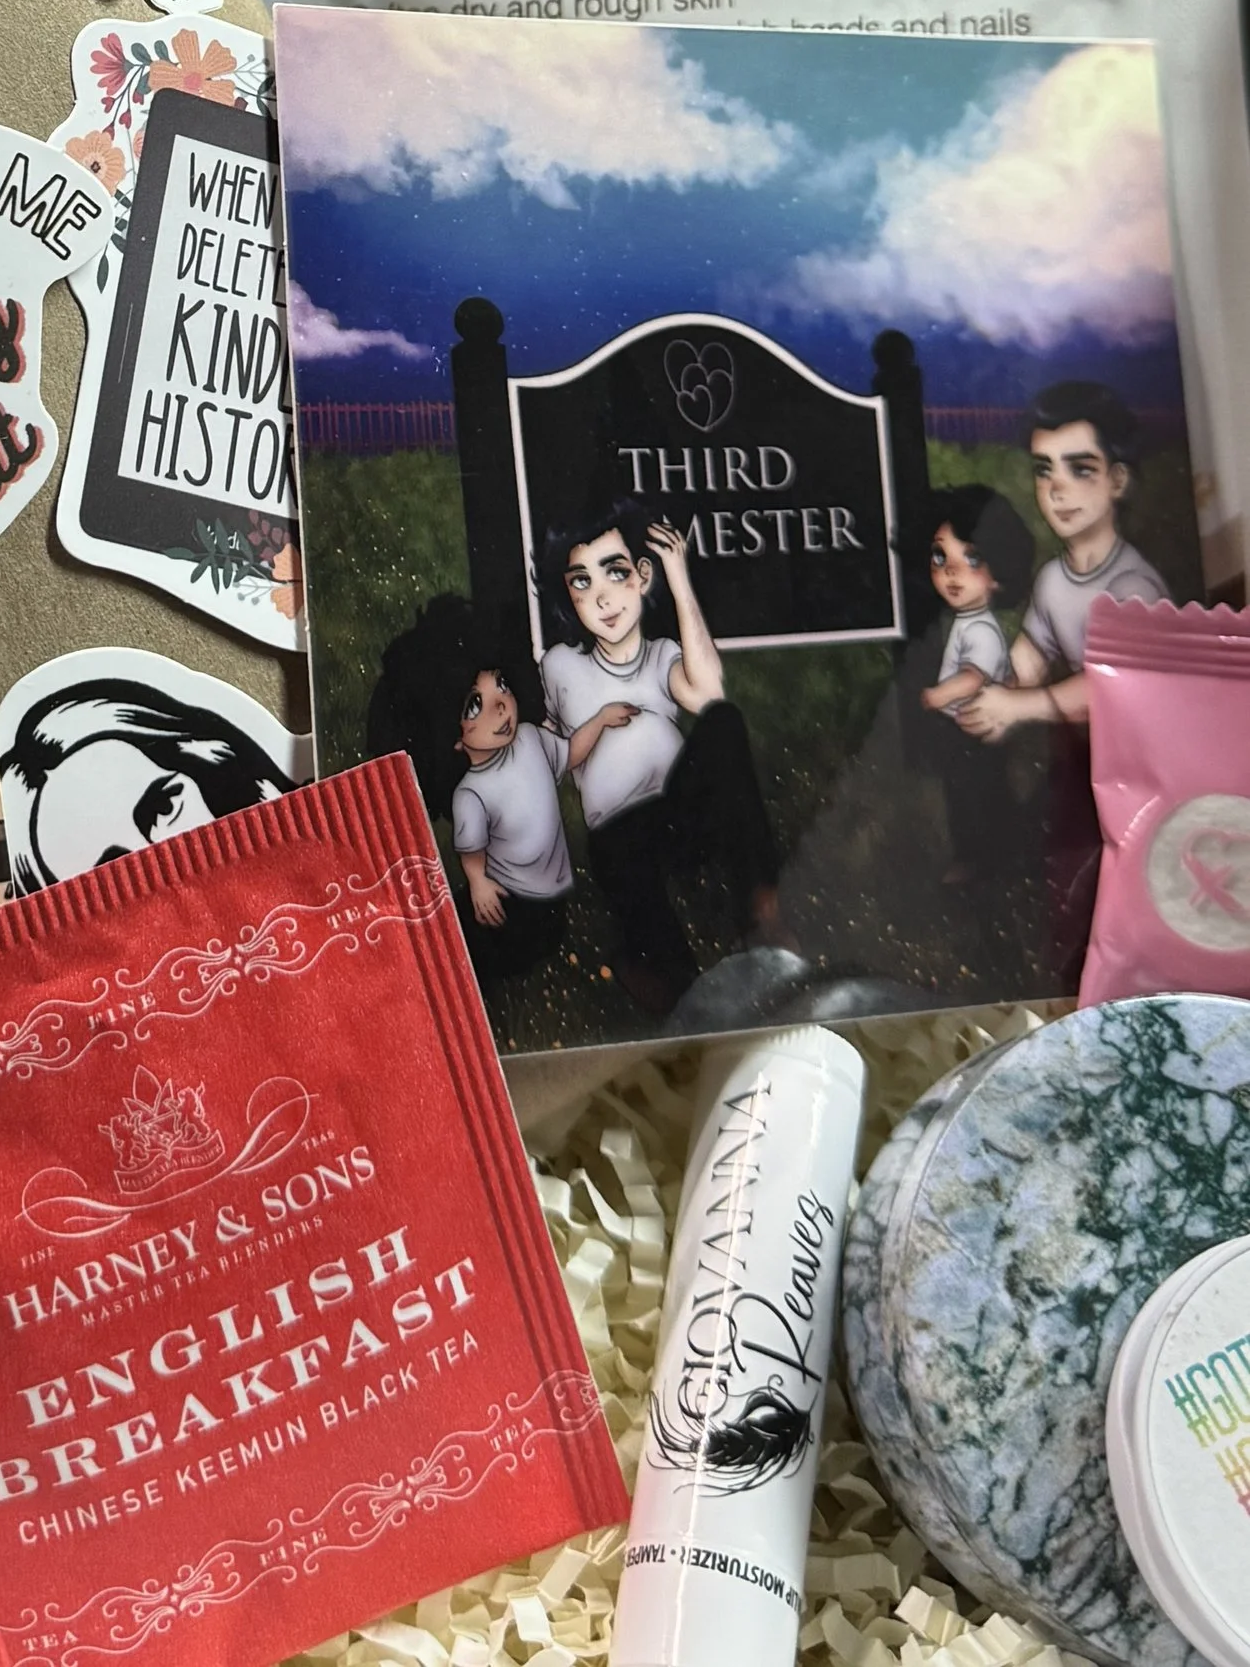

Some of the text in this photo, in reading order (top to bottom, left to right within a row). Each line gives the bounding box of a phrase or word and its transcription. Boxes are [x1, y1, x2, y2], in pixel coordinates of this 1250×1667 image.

[890, 11, 949, 34] and
[960, 8, 1032, 36] nails
[190, 151, 279, 230] WHEN
[618, 446, 797, 495] THIRD
[87, 991, 158, 1034] FINE
[326, 900, 380, 931] TEA
[3, 1145, 376, 1332] HARNEY & SONS
[81, 1213, 325, 1327] MASTER TEA BLENDERS
[726, 1188, 835, 1385] Reaves
[17, 1225, 418, 1431] ENGLISH
[19, 1329, 481, 1546] CHINESE KEEMUN BLACK TEA
[22, 1417, 535, 1651] TEA FINE TEA
